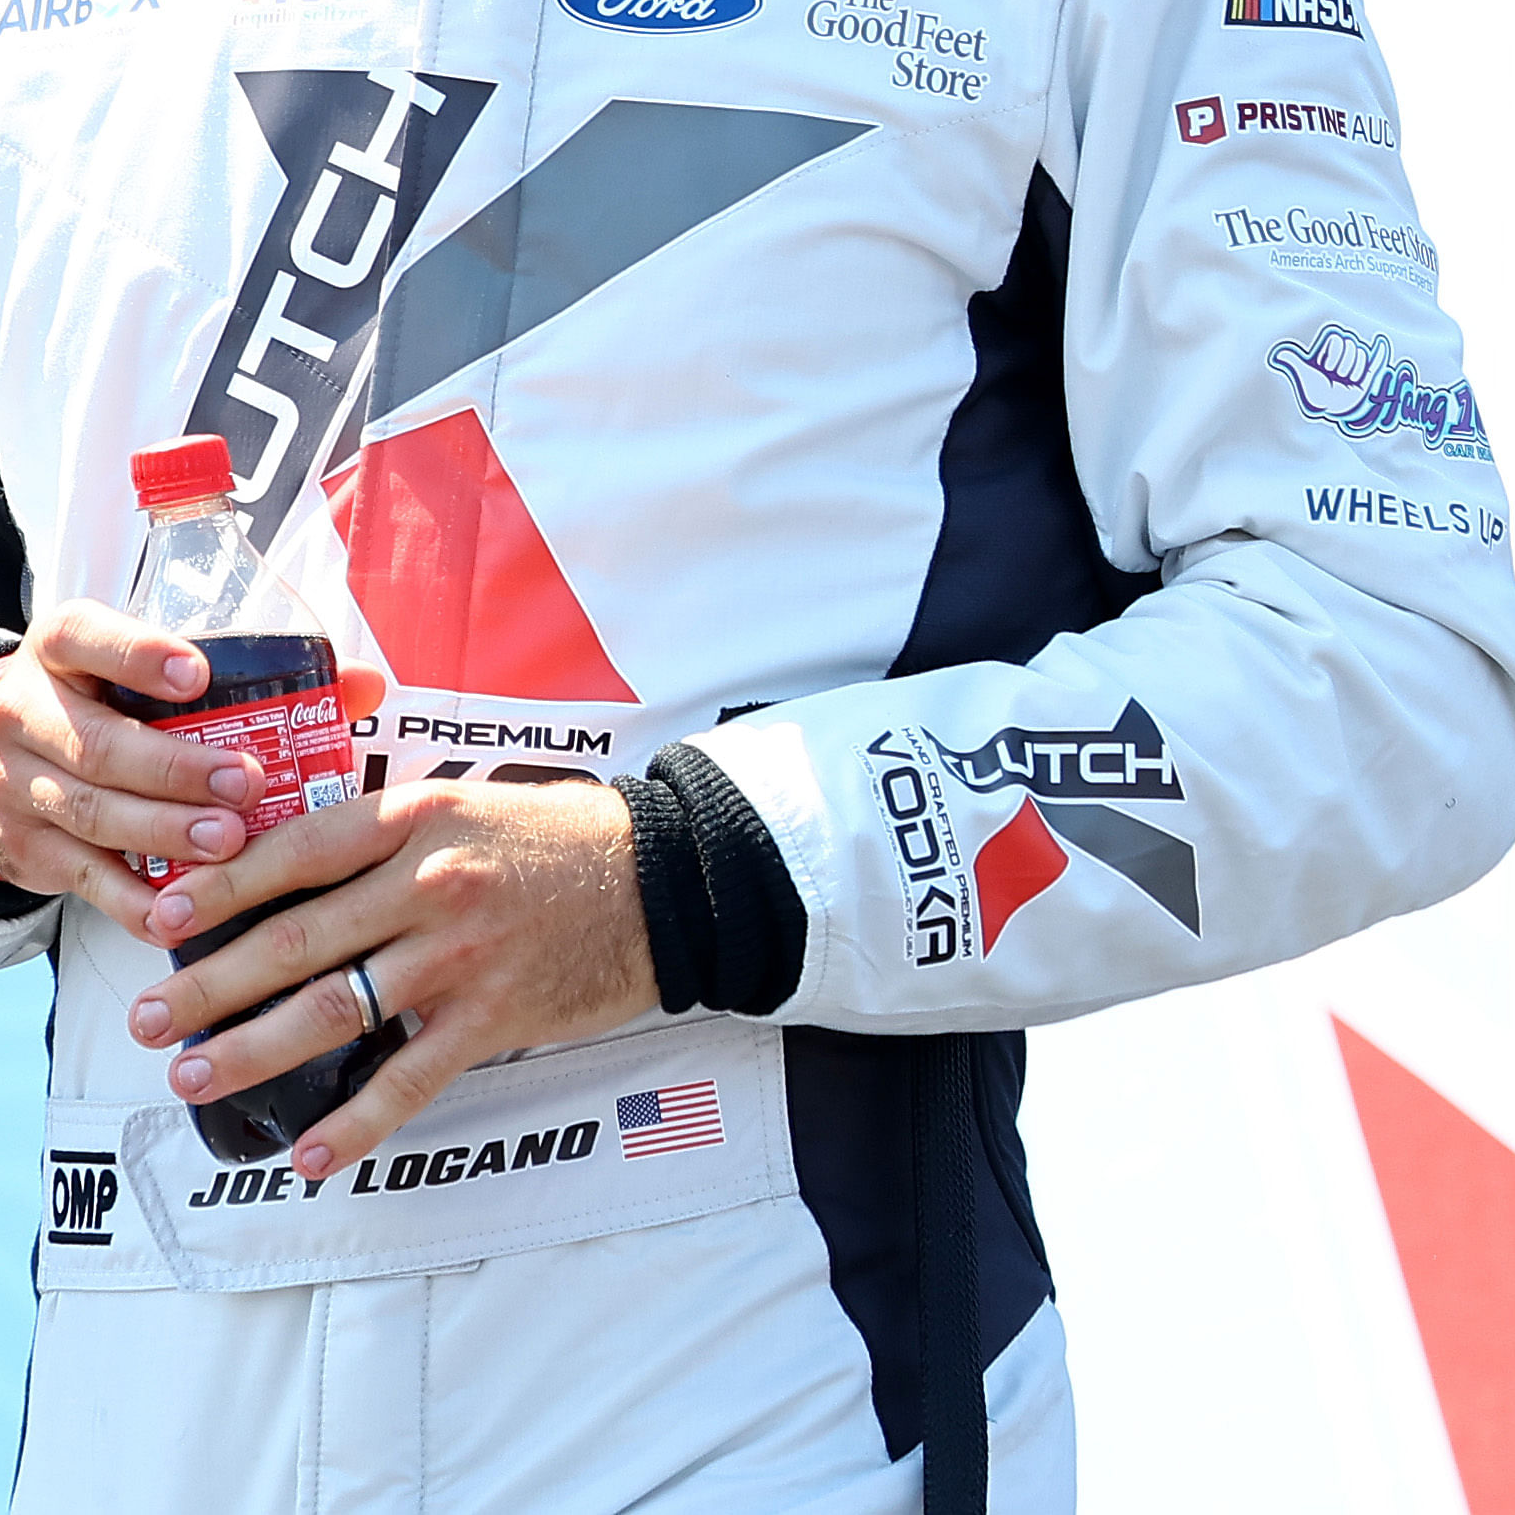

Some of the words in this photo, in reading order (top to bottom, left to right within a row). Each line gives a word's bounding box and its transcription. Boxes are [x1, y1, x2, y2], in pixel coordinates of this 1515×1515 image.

[807, 0, 908, 47] Good
[912, 13, 986, 61] Feet
[1237, 101, 1347, 139] PRISTINE
[1214, 207, 1284, 248] The
[1287, 208, 1364, 248] Good
[1361, 214, 1411, 258] Feet
[1406, 226, 1438, 276] Stor
[1270, 250, 1333, 269] America's
[1334, 254, 1364, 271] Arch
[1367, 256, 1408, 280] Support
[226, 68, 447, 537] UTCH
[1346, 370, 1449, 440] Hang
[1443, 443, 1475, 459] CAR
[1306, 487, 1470, 534] WHEELS
[1479, 507, 1503, 551] UP
[398, 716, 613, 756] PREMIUM
[866, 730, 956, 967] VODKA
[901, 727, 931, 765] HAND
[927, 772, 960, 866] CRAFTED
[955, 874, 972, 958] PREMIUM
[351, 1120, 601, 1196] LOGANO
[53, 1167, 118, 1229] OMP
